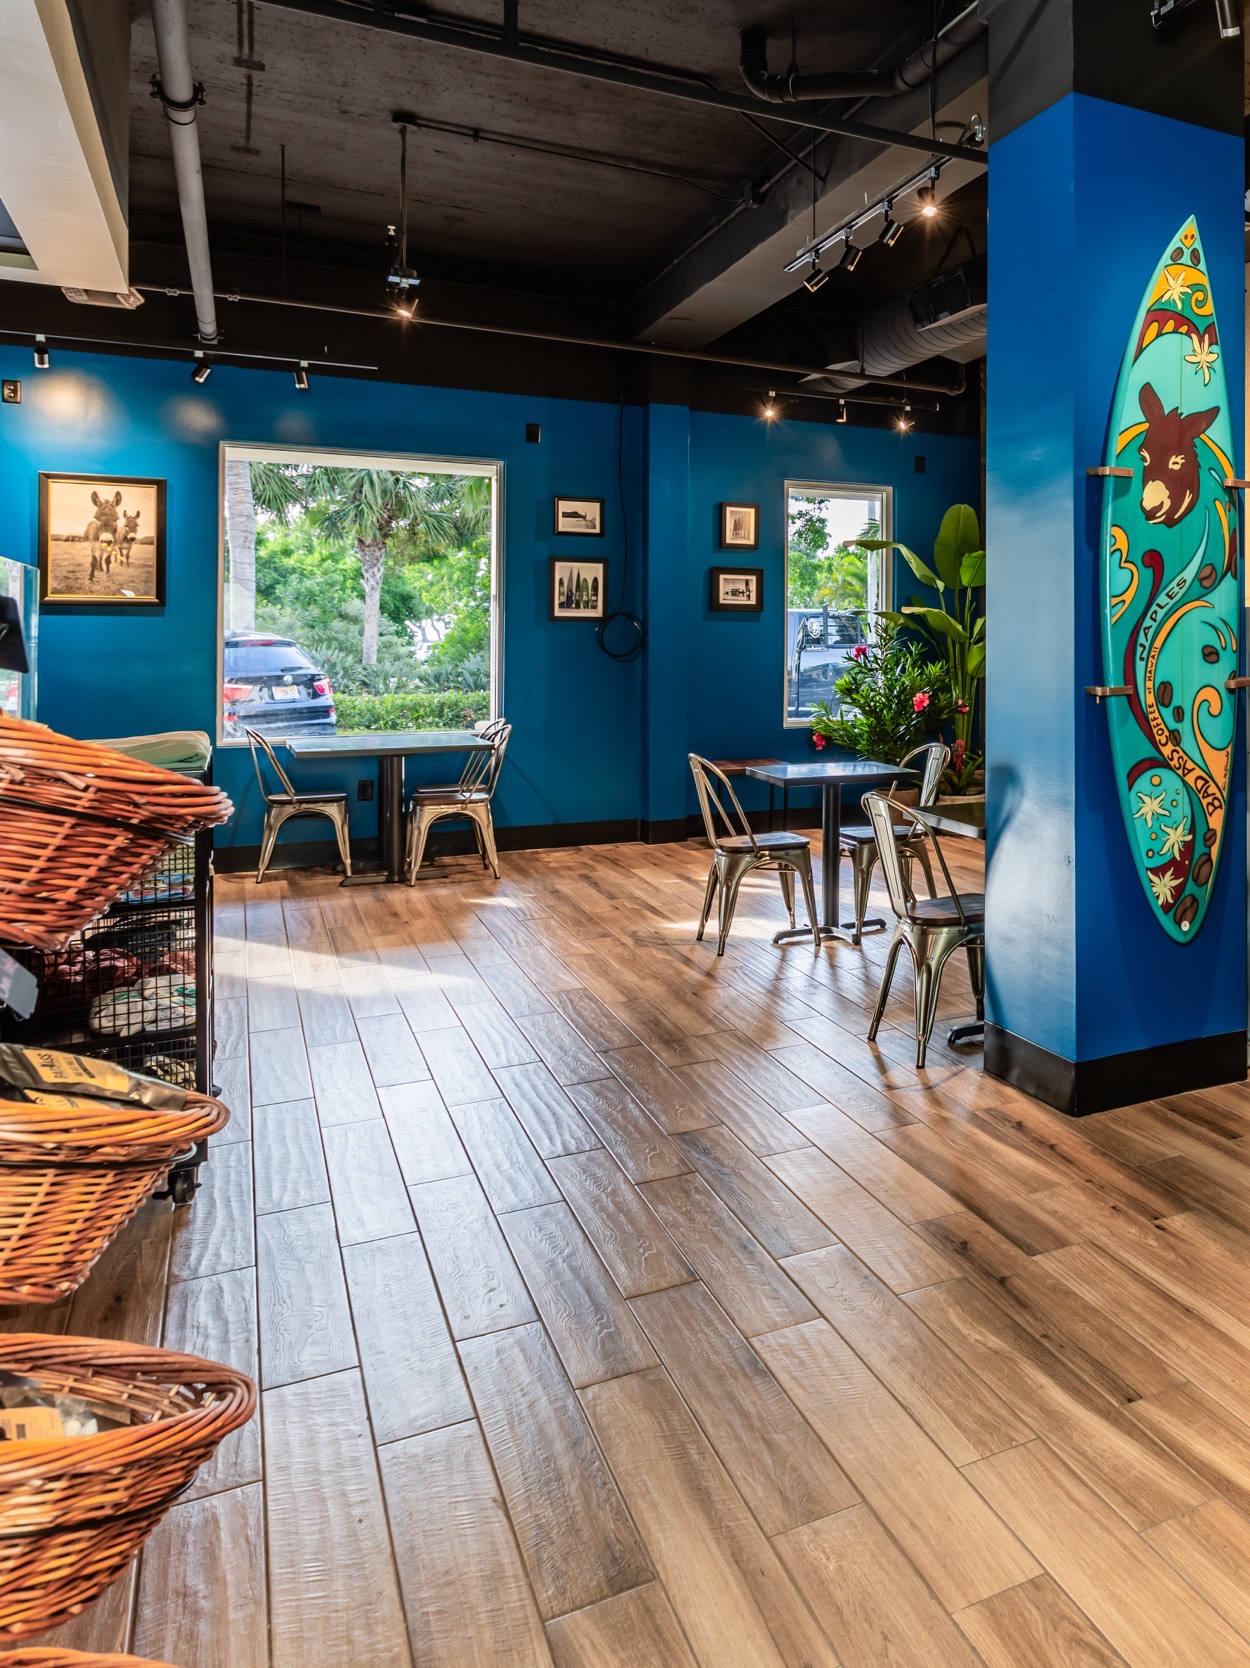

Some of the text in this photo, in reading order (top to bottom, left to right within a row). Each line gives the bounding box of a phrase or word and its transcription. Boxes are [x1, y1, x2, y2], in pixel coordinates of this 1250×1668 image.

[1139, 577, 1187, 661] NAPLES
[1147, 647, 1159, 681] HAWAII
[1149, 703, 1169, 747] COFFEE
[1167, 748, 1196, 778] ASS
[1194, 775, 1223, 817] BAD
